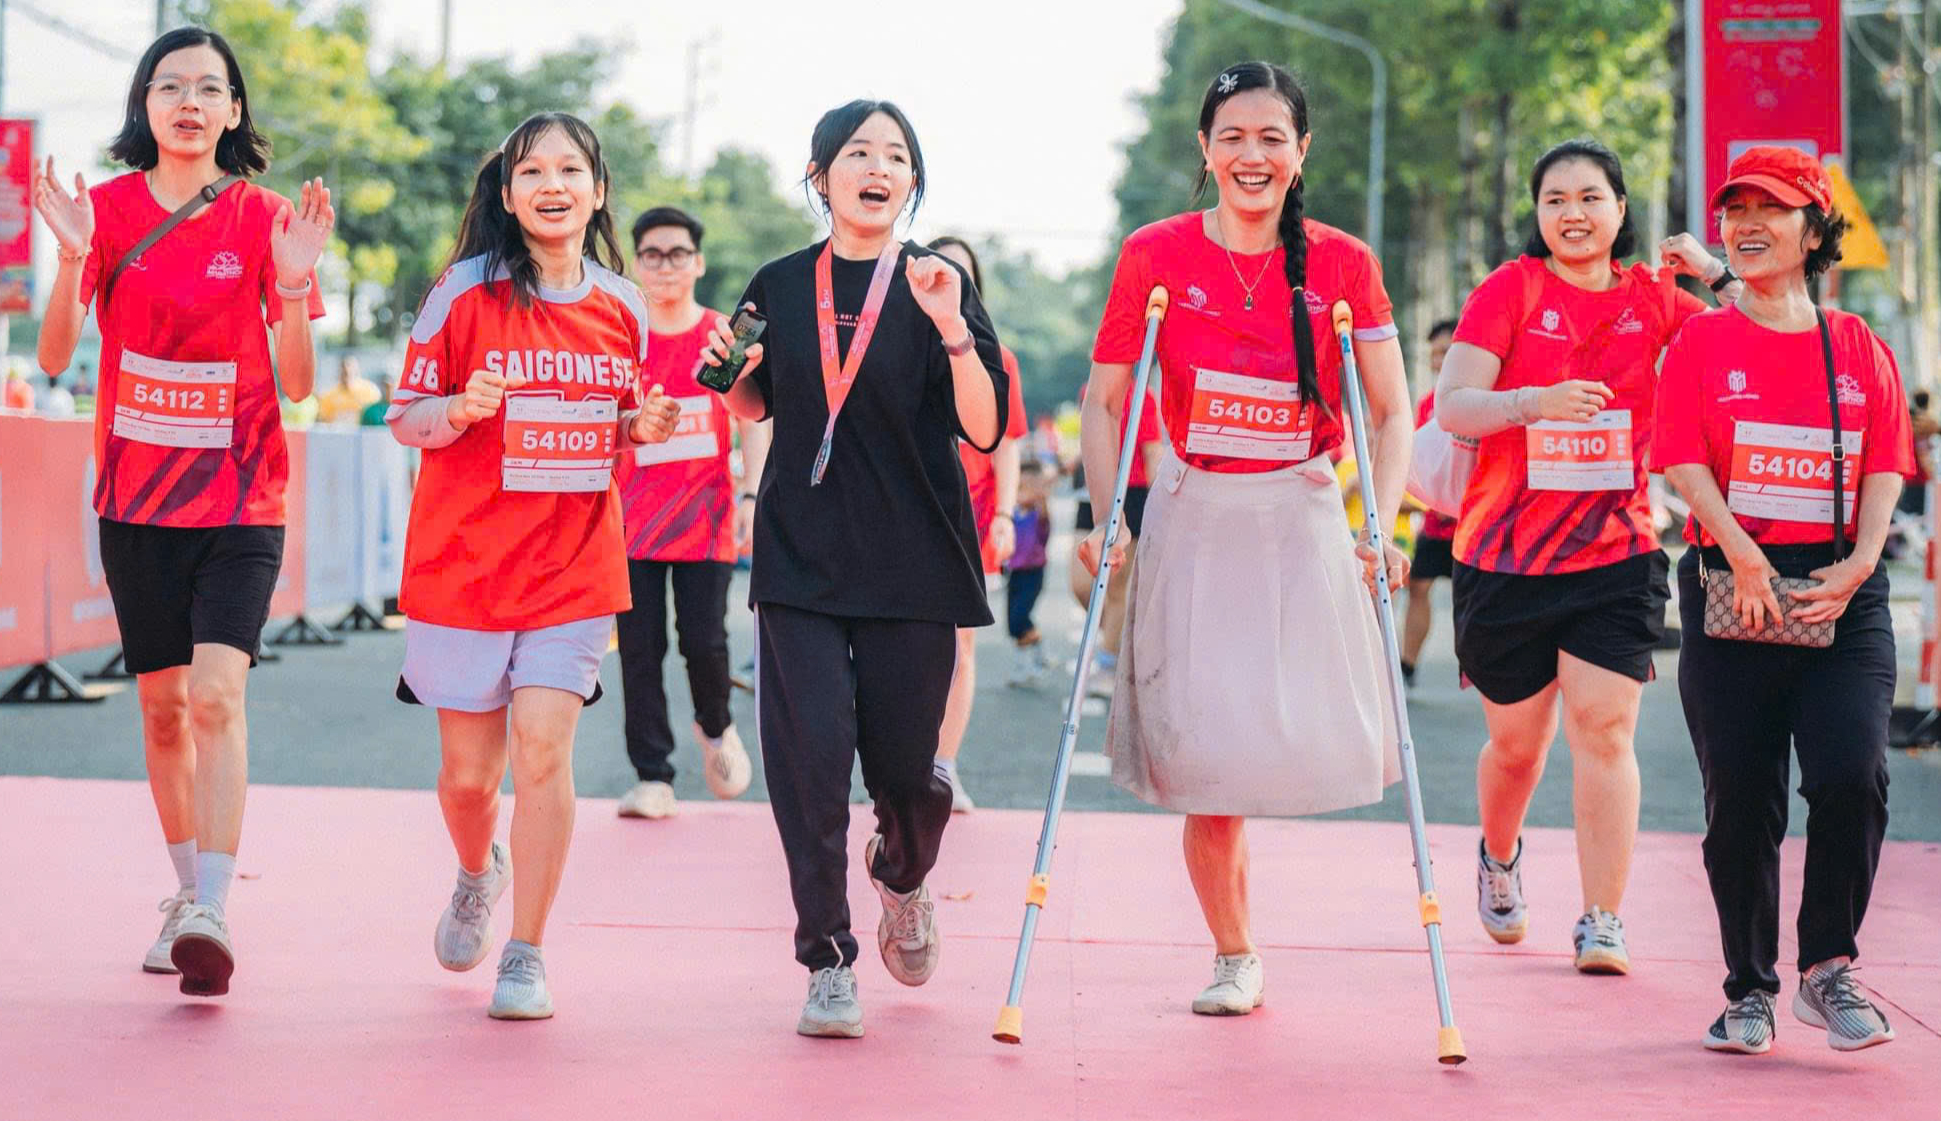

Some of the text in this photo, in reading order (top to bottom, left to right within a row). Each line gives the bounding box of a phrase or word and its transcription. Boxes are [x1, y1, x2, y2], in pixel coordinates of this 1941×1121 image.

[408, 356, 439, 390] 56
[485, 350, 634, 389] SAIGONESE
[134, 383, 205, 410] 54112
[1208, 399, 1291, 426] 54103
[522, 430, 598, 452] 54109
[1542, 436, 1606, 456] 54110
[1748, 453, 1833, 481] 54104
